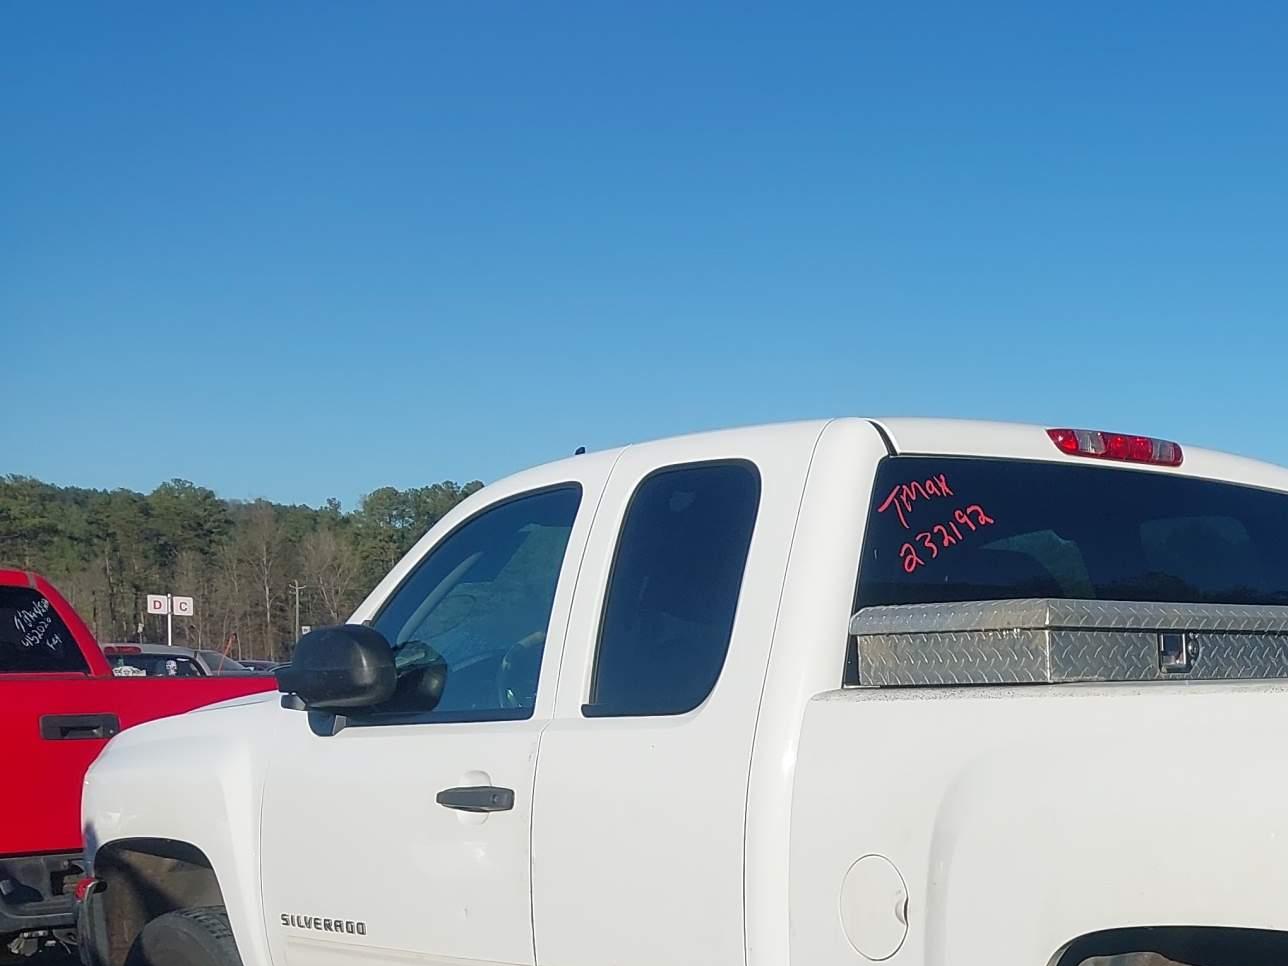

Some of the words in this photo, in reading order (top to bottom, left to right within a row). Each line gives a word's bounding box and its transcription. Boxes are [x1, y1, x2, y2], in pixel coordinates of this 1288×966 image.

[900, 504, 995, 573] 232192
[153, 600, 162, 610] D
[179, 602, 188, 611] C
[280, 913, 367, 936] SILVERADO
